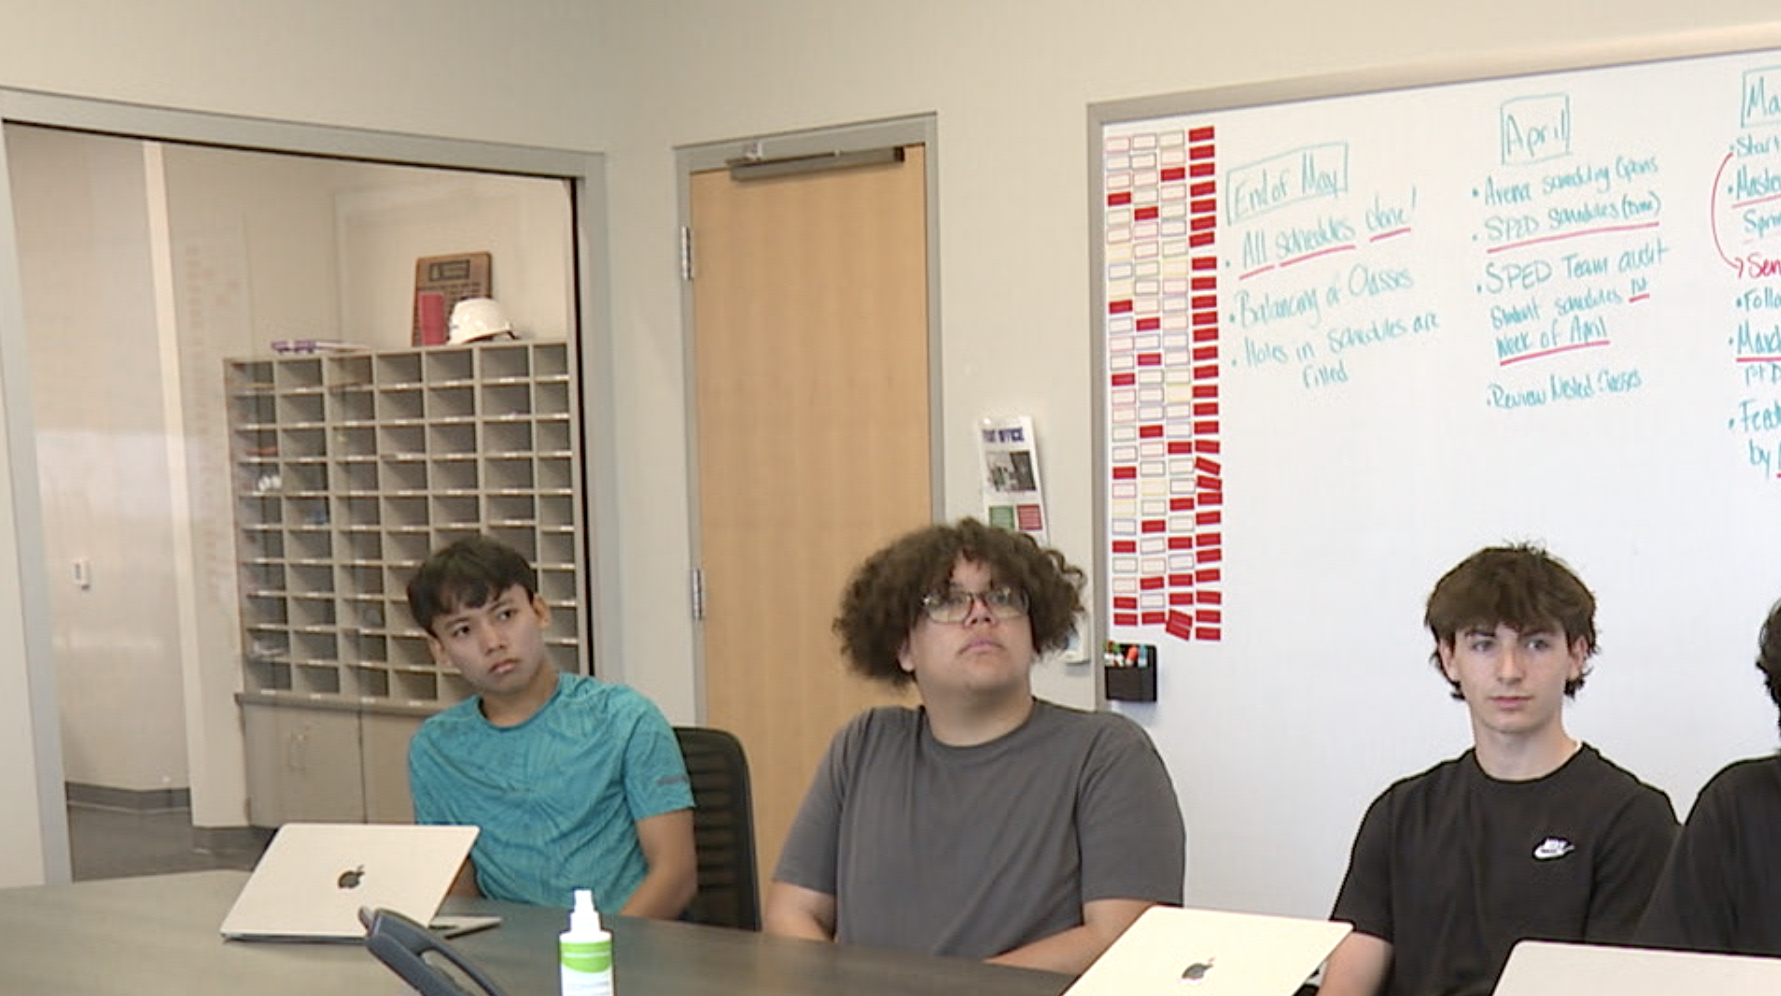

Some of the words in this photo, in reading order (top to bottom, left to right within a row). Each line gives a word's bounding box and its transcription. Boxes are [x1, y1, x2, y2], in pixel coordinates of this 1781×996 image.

[1506, 108, 1566, 157] April
[1235, 169, 1268, 218] End
[1272, 170, 1289, 201] of
[1302, 152, 1339, 198] May
[1242, 229, 1268, 270] All
[1486, 259, 1553, 294] SPED
[1618, 237, 1670, 273] audit
[1296, 341, 1315, 362] in
[1540, 317, 1558, 348] of
[1749, 438, 1772, 479] by
